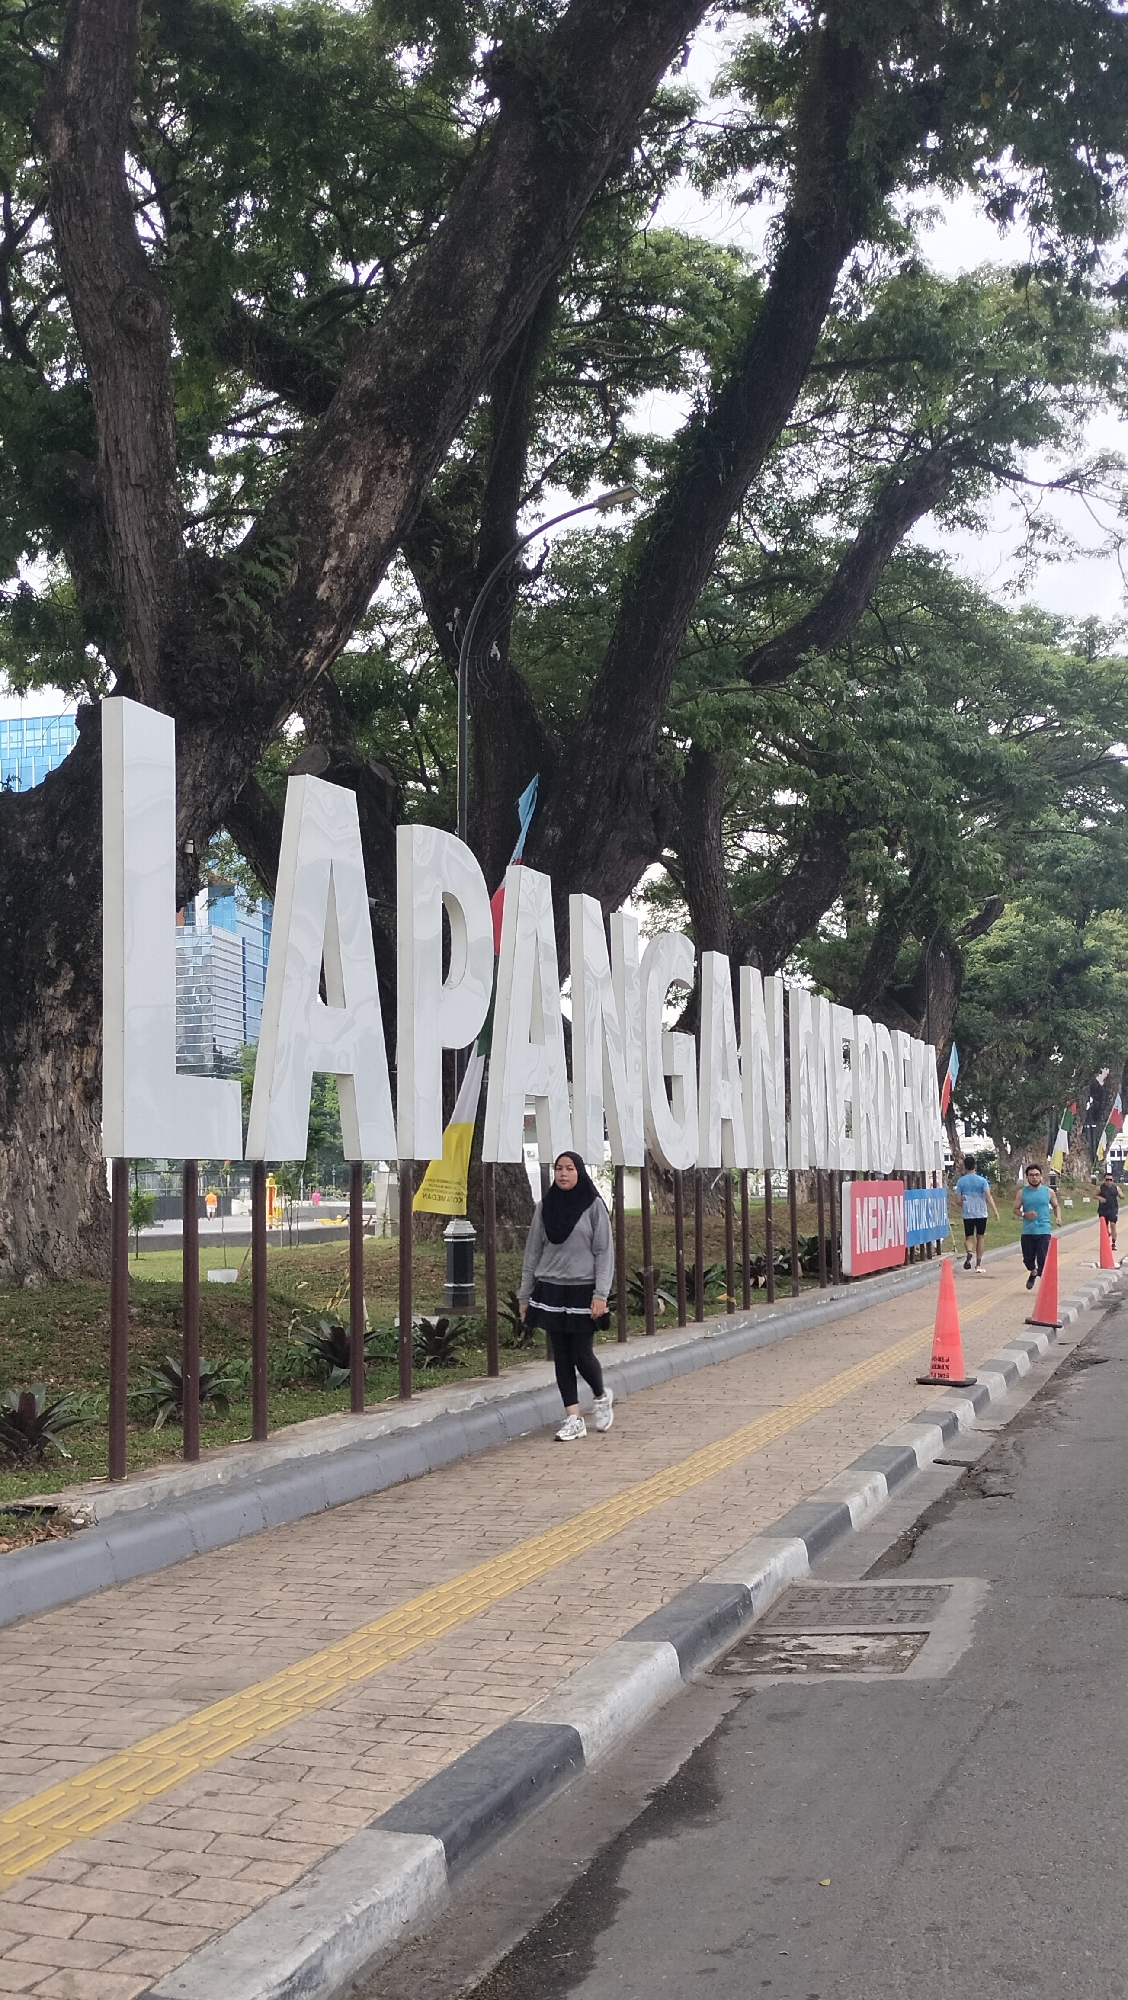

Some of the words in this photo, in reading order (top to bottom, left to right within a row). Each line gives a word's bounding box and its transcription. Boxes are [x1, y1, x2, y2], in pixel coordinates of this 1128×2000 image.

[101, 695, 786, 1171] LAPANGAN
[788, 988, 946, 1174] MERDEKA
[856, 1195, 904, 1254] MEDAN
[905, 1199, 928, 1232] UNTUK
